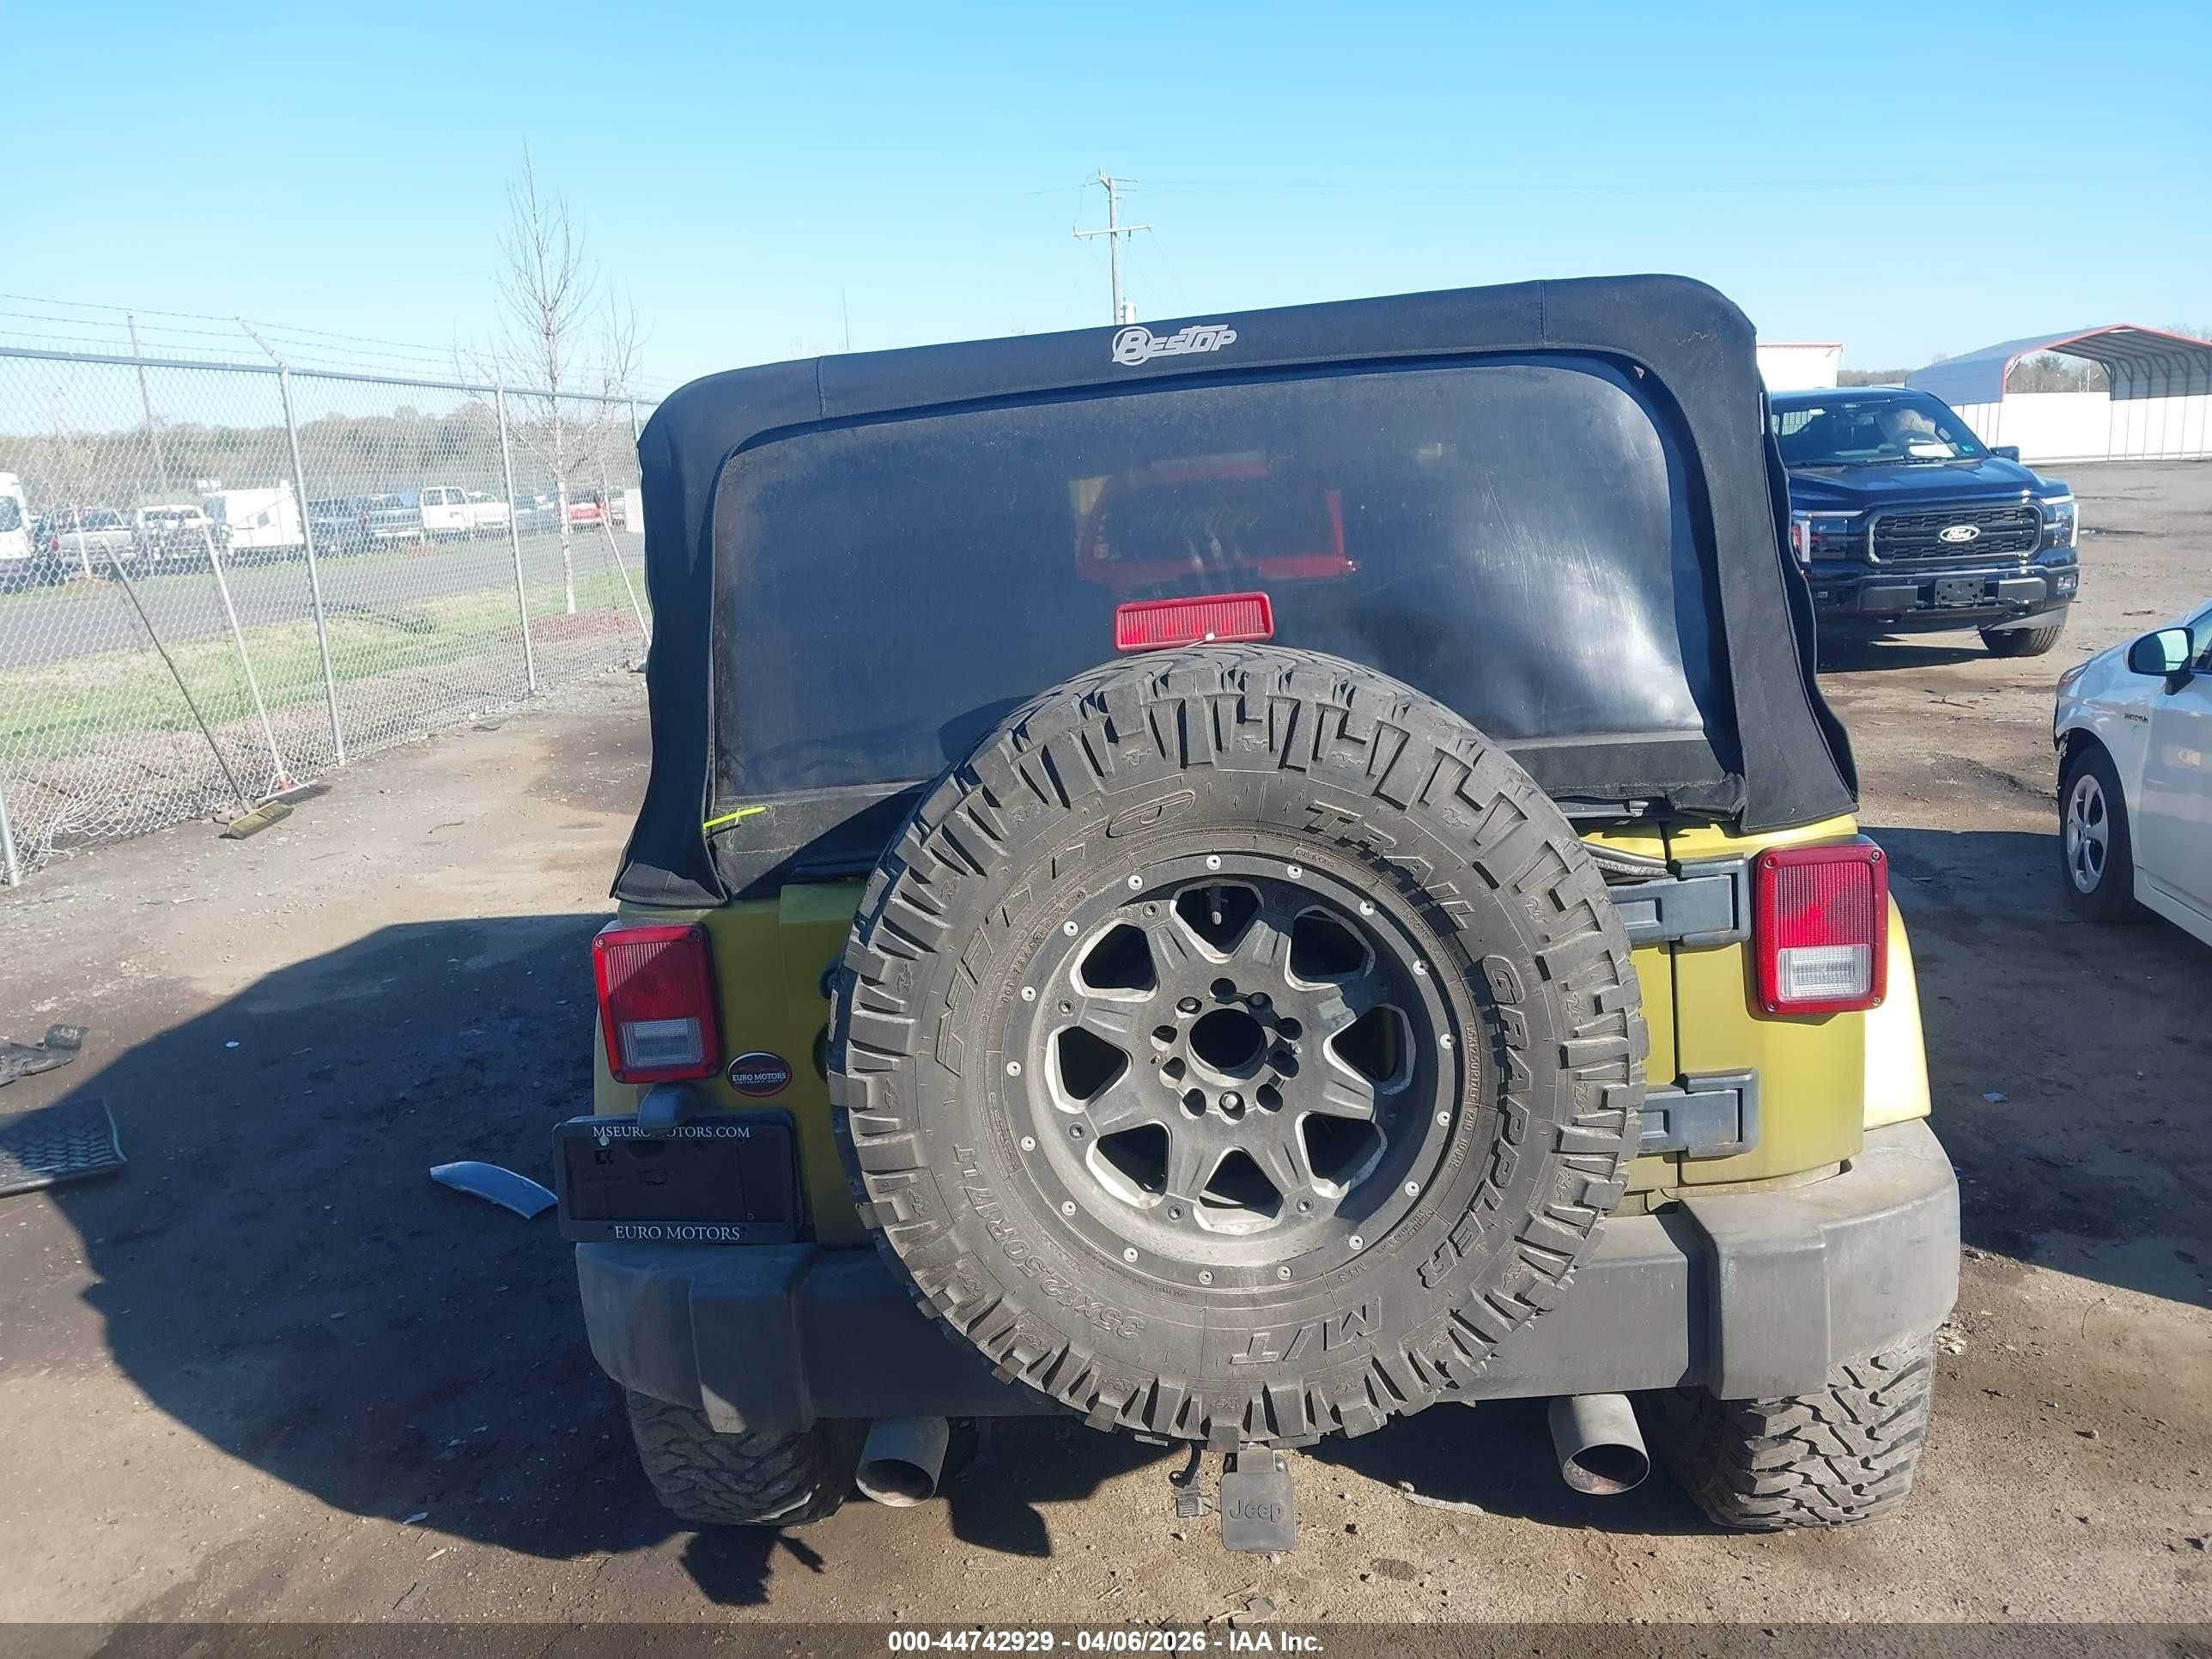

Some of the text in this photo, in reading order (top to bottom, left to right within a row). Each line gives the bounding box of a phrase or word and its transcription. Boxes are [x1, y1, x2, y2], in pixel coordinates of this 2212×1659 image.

[732, 1073, 753, 1082] EURO
[755, 1072, 787, 1081] MOTORS
[1230, 799, 1532, 1364] TRAIL GRAPPLER M/T
[592, 1126, 750, 1139] MSEUROOTORS.COM
[614, 1225, 740, 1241] EURO MOTORS
[1229, 1498, 1285, 1523] Jeep
